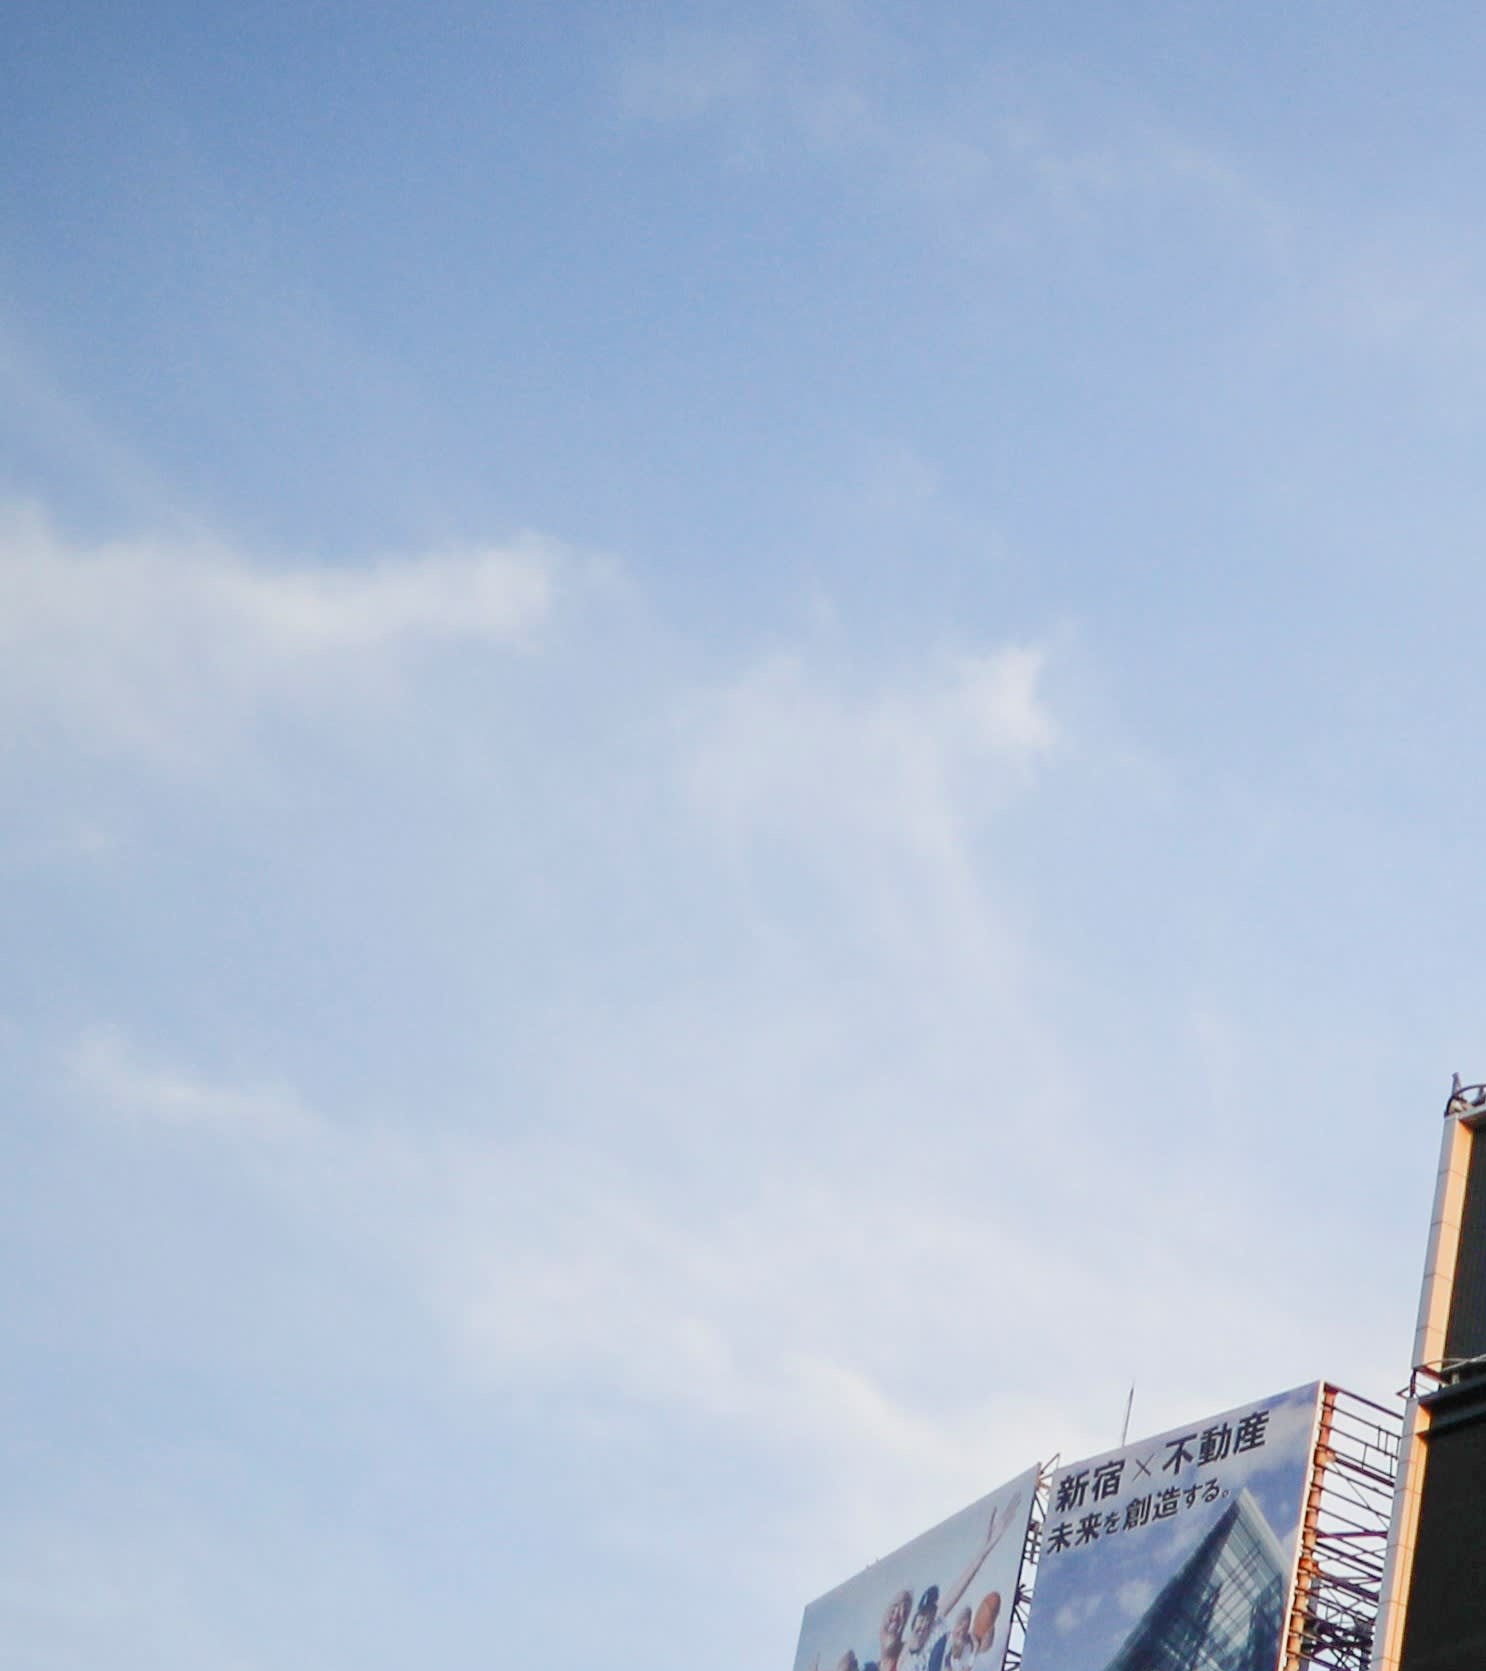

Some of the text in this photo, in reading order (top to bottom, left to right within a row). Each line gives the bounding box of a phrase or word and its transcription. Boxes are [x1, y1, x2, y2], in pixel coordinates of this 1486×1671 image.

[1046, 1477, 1230, 1555] 未来を創造する。
